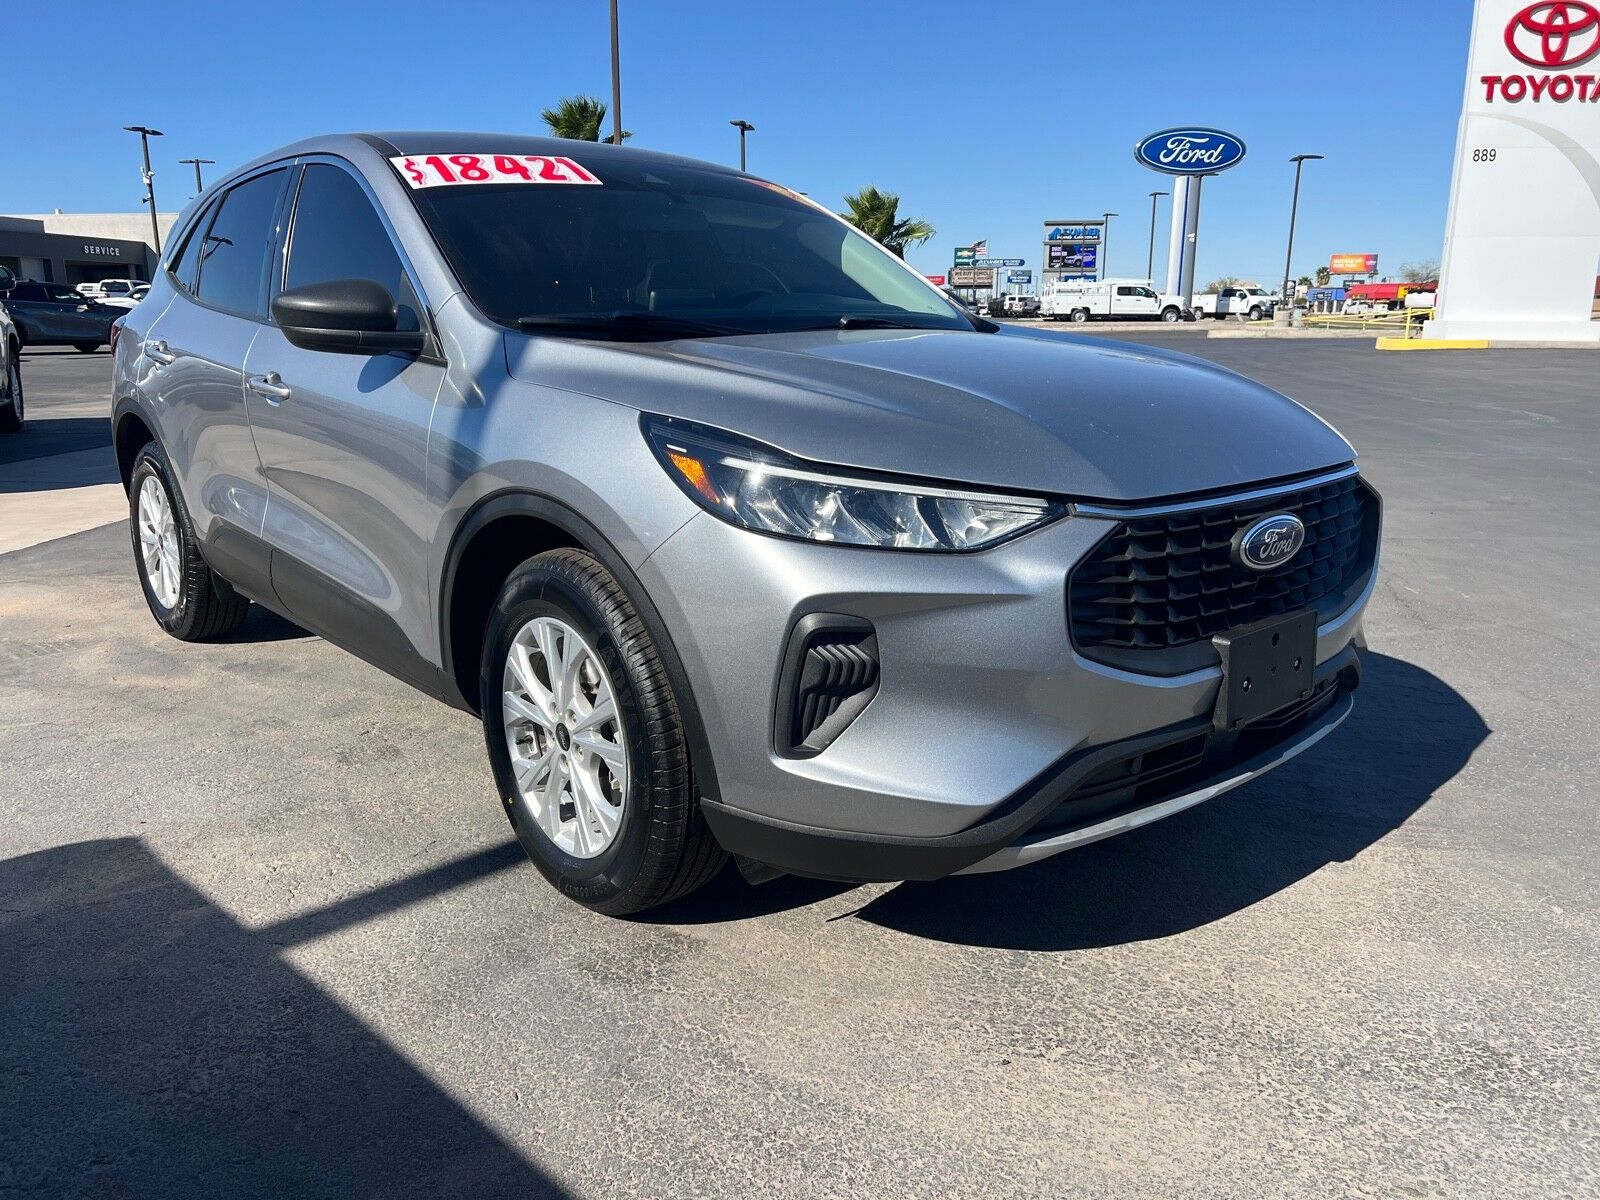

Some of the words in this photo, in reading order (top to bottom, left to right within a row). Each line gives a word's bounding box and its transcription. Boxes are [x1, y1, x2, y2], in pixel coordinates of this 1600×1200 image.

[1159, 136, 1225, 163] Ford
[1472, 148, 1497, 162] 889
[404, 155, 595, 186] $18421
[1048, 227, 1101, 240] ALEXANDER
[84, 245, 120, 256] SERVICE
[1259, 527, 1296, 559] Ford
